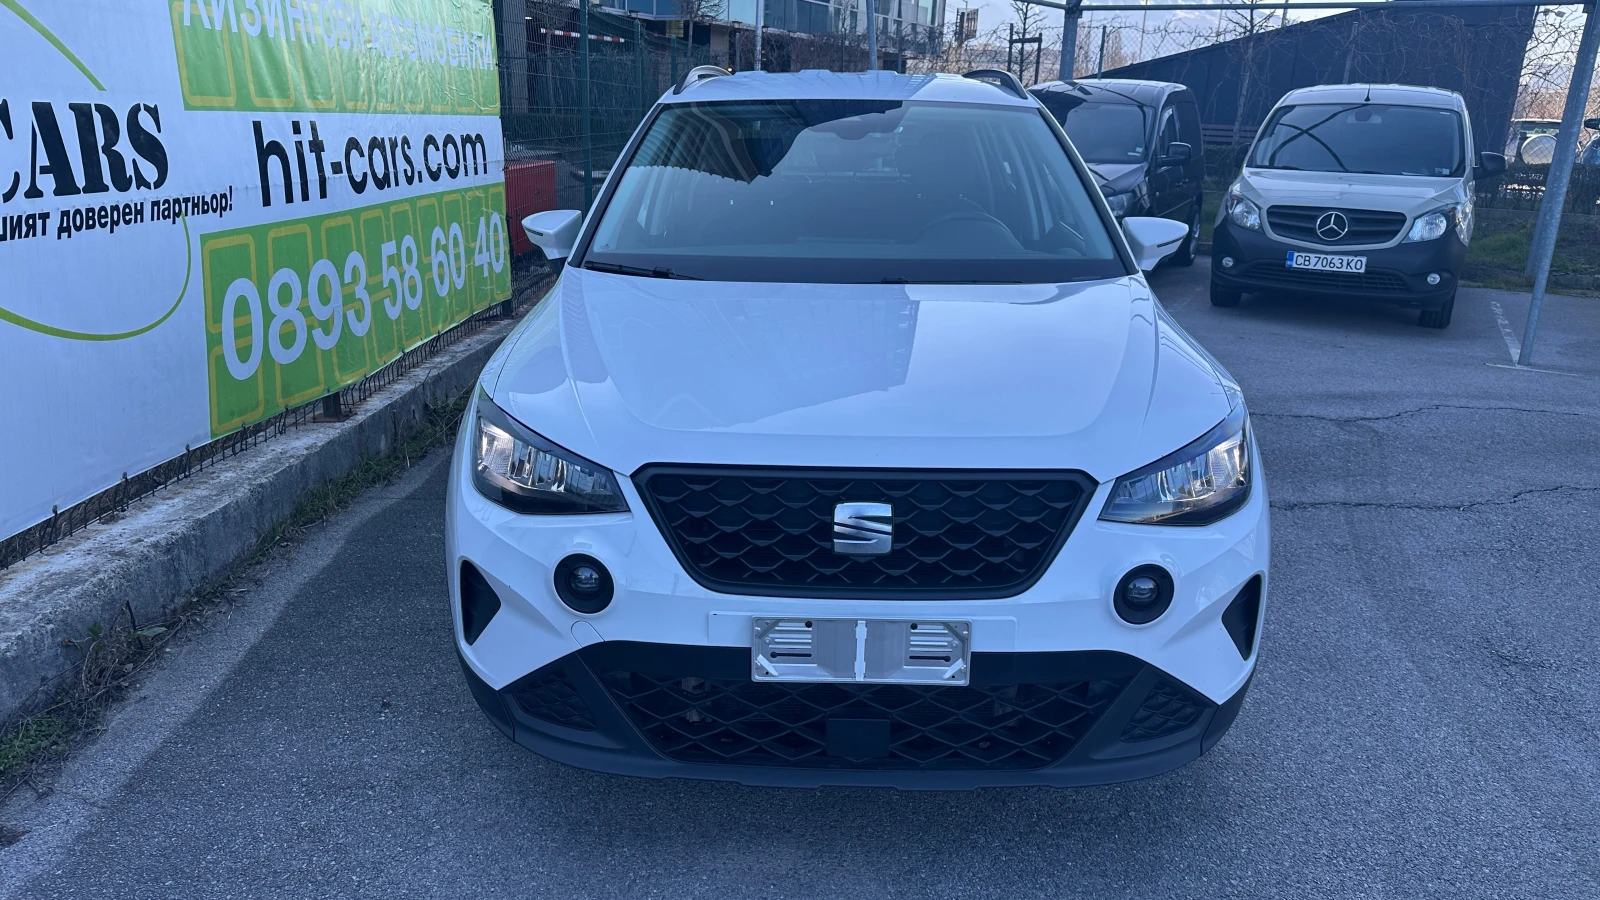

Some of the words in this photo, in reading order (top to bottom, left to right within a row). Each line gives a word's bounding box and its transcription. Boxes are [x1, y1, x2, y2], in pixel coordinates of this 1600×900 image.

[369, 10, 493, 70] АВТОМОБИЛИ
[253, 120, 488, 207] hit-cars.com
[57, 201, 144, 240] доверен
[150, 185, 233, 224] партньор!
[222, 250, 372, 381] 0893
[381, 234, 423, 320] 58
[431, 222, 466, 297] 60
[475, 212, 505, 278] 40
